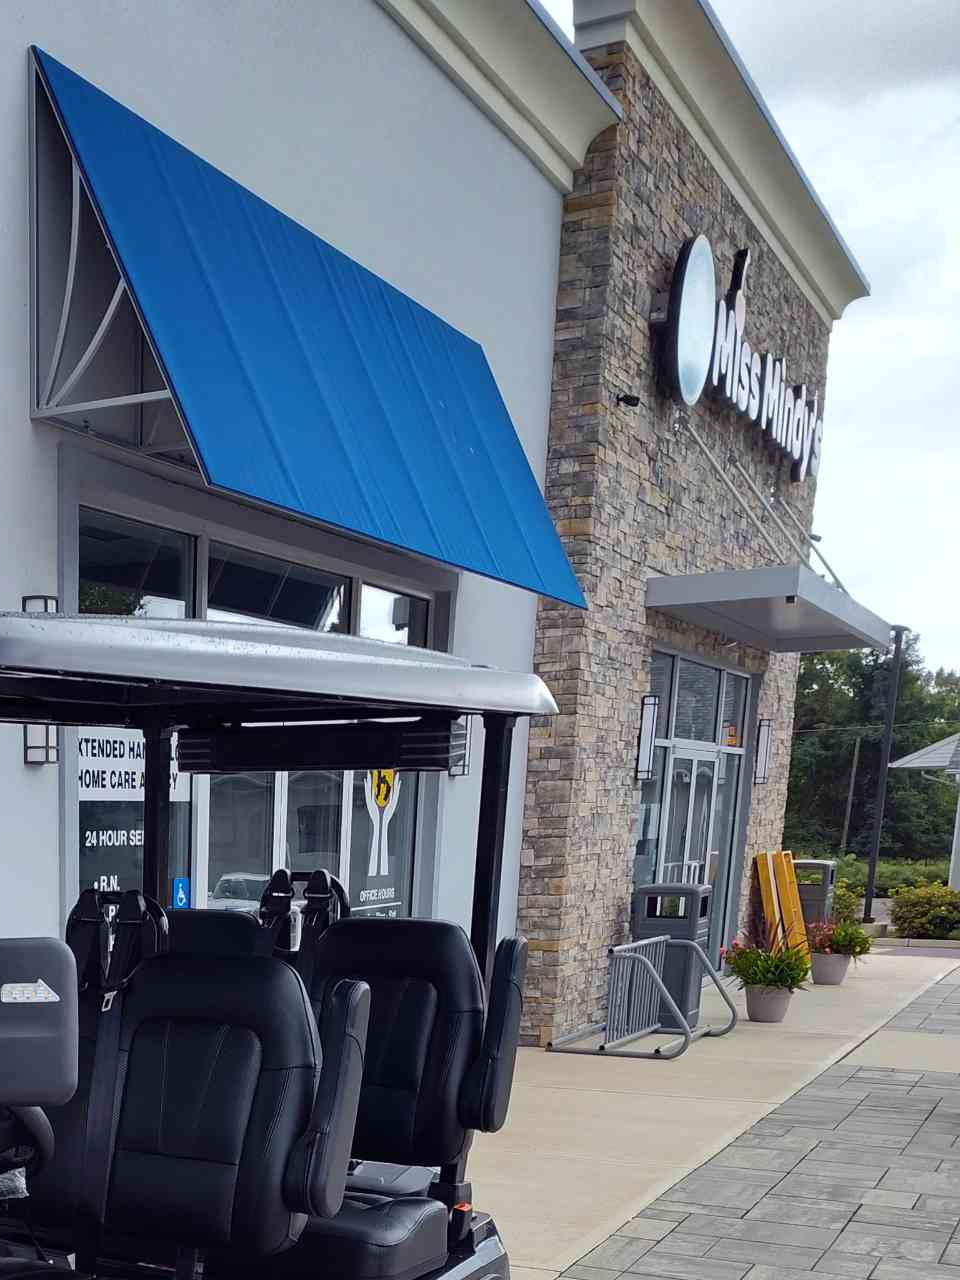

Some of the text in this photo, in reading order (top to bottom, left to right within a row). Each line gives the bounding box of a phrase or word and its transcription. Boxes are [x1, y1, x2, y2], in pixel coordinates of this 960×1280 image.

[78, 738, 125, 758] XTENDED
[78, 769, 107, 789] HOME
[110, 770, 137, 789] CARE
[85, 831, 97, 846] 24
[99, 830, 128, 846] HOUR
